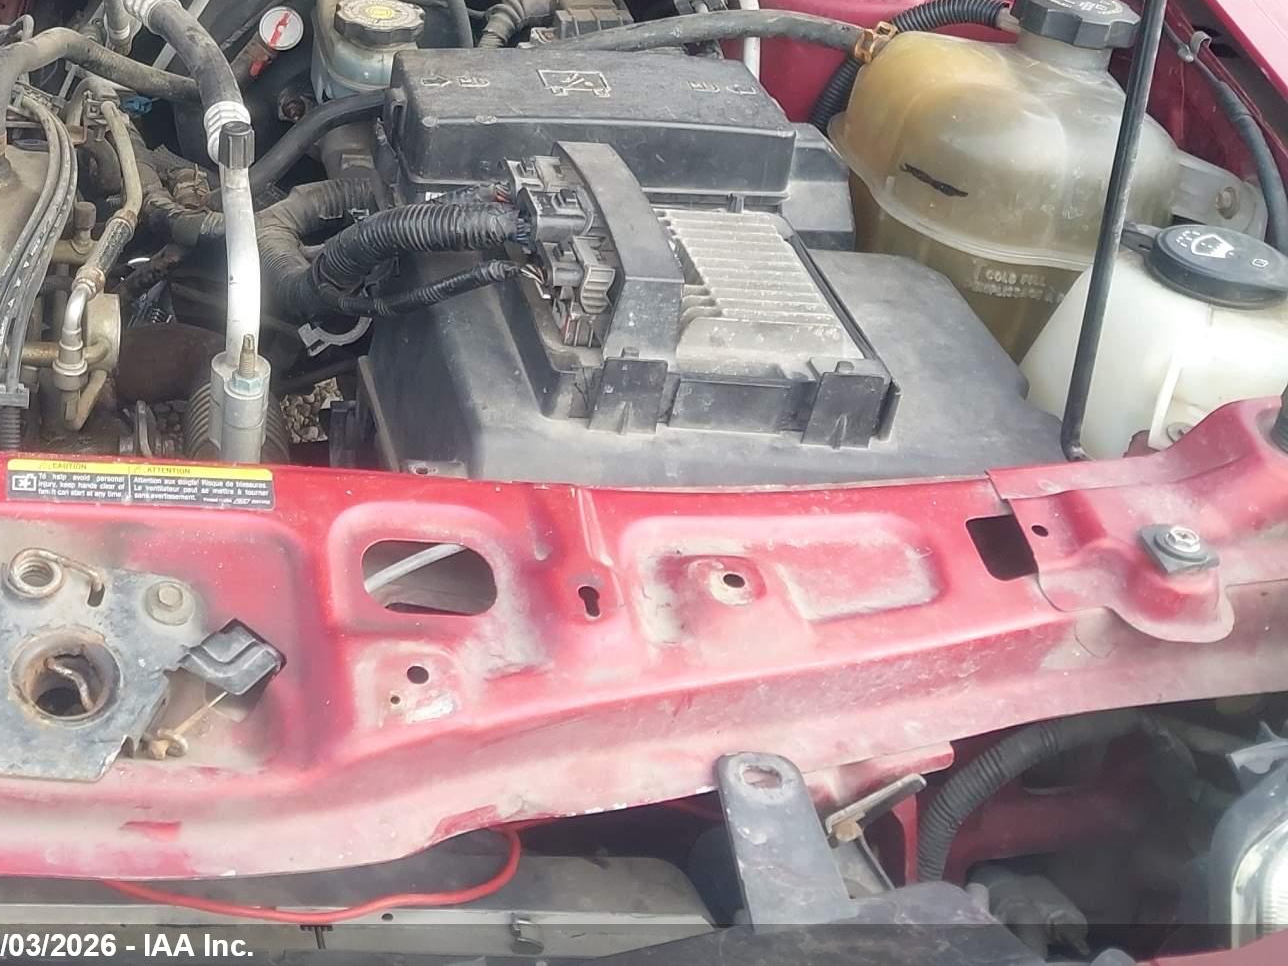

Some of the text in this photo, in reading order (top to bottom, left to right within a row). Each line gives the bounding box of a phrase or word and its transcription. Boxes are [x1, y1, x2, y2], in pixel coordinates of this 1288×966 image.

[985, 269, 1017, 284] COLD
[52, 462, 87, 470] CAUTION
[147, 467, 190, 475] ATTENTION
[52, 473, 67, 481] help
[73, 474, 90, 482] avoid
[96, 476, 124, 484] personal
[134, 477, 162, 485] Attention
[202, 480, 223, 488] Risque
[59, 482, 76, 490] keep
[78, 482, 97, 490] hands
[134, 484, 142, 492] Le
[146, 485, 180, 493] ventilateur
